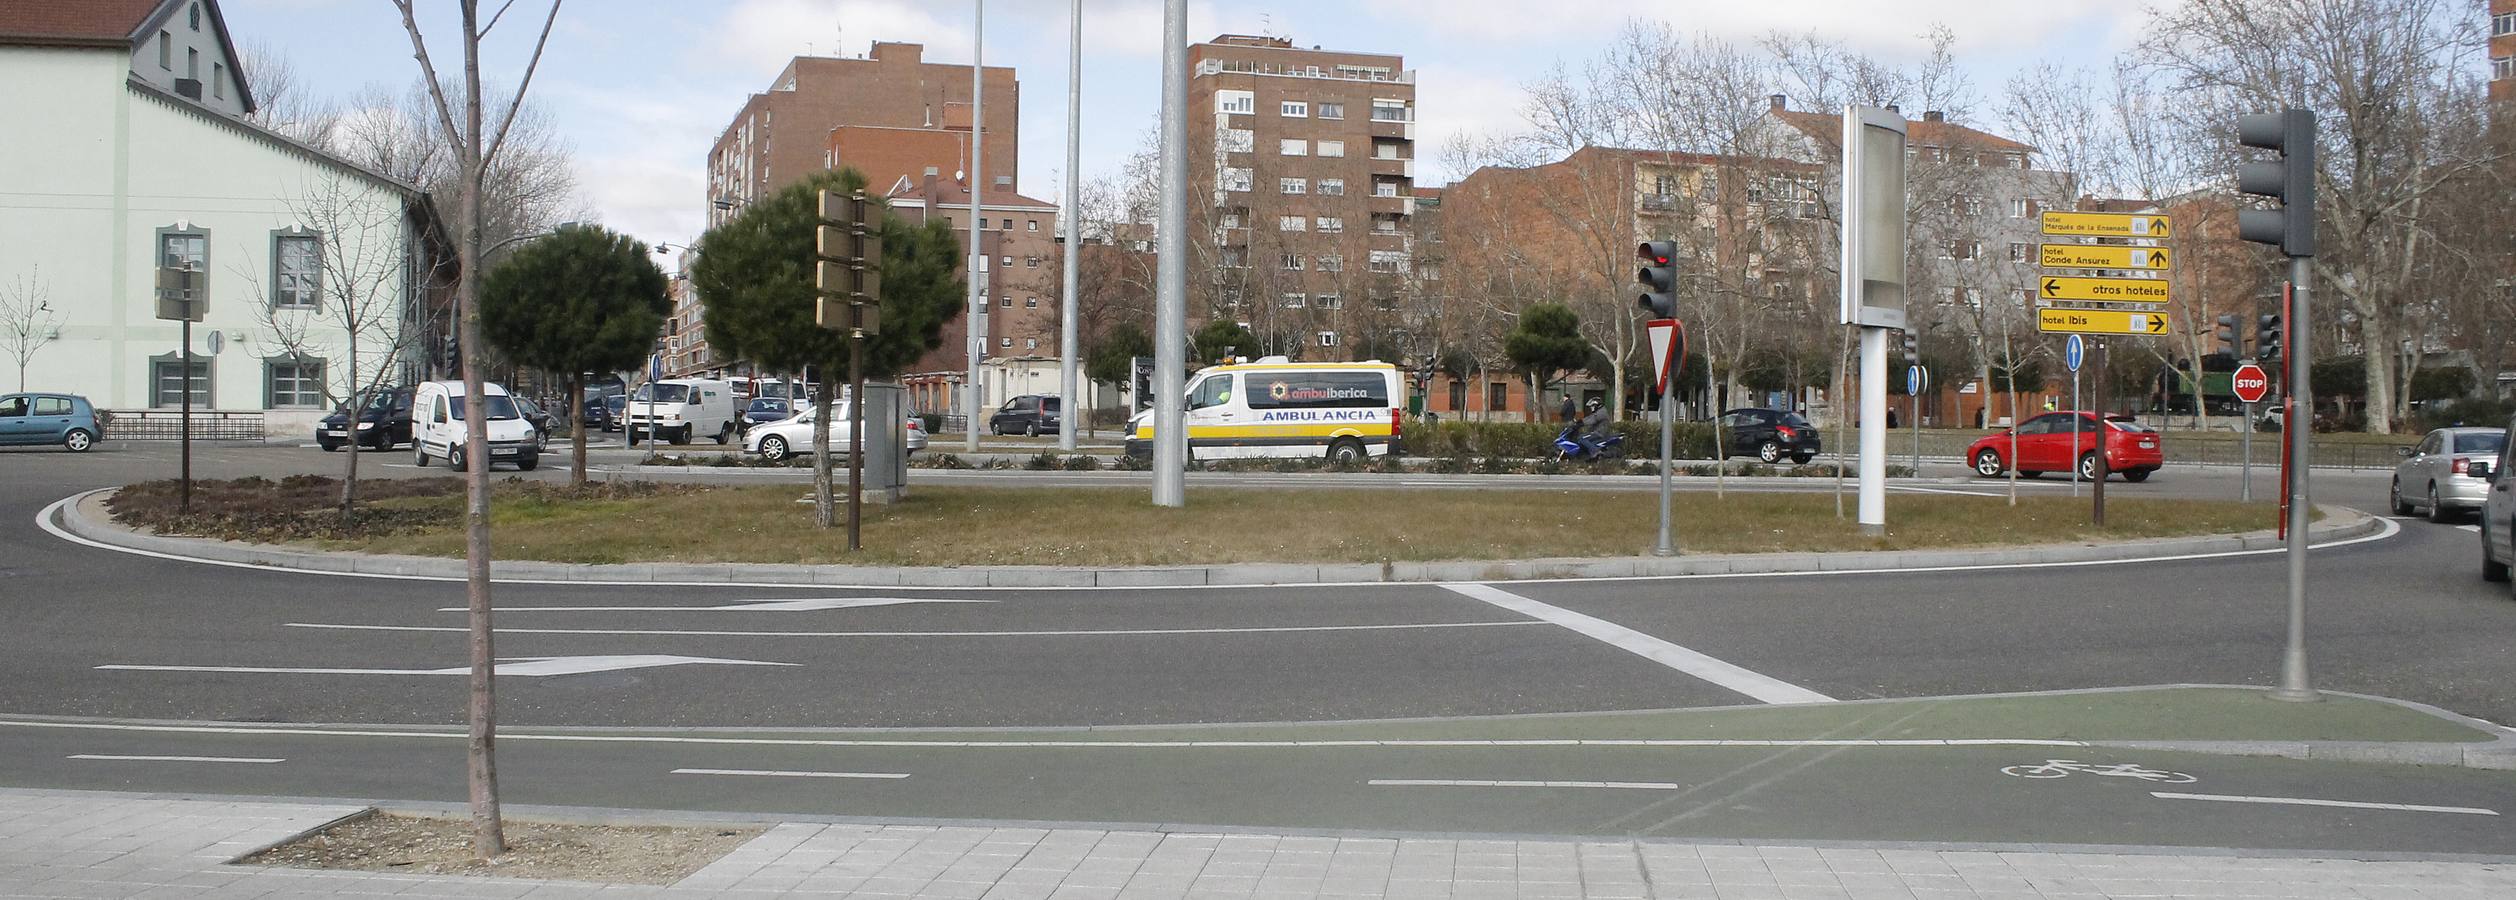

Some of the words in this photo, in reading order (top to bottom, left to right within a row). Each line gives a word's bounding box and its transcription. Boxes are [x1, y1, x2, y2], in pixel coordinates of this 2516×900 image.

[2044, 255, 2072, 264] Conde
[2092, 285, 2121, 295] otros
[2125, 286, 2167, 297] hoteles
[2042, 316, 2065, 325] hotel
[2068, 315, 2088, 325] Ibis
[2237, 379, 2263, 388] STOP
[1263, 411, 1376, 421] AMBULANCIA
